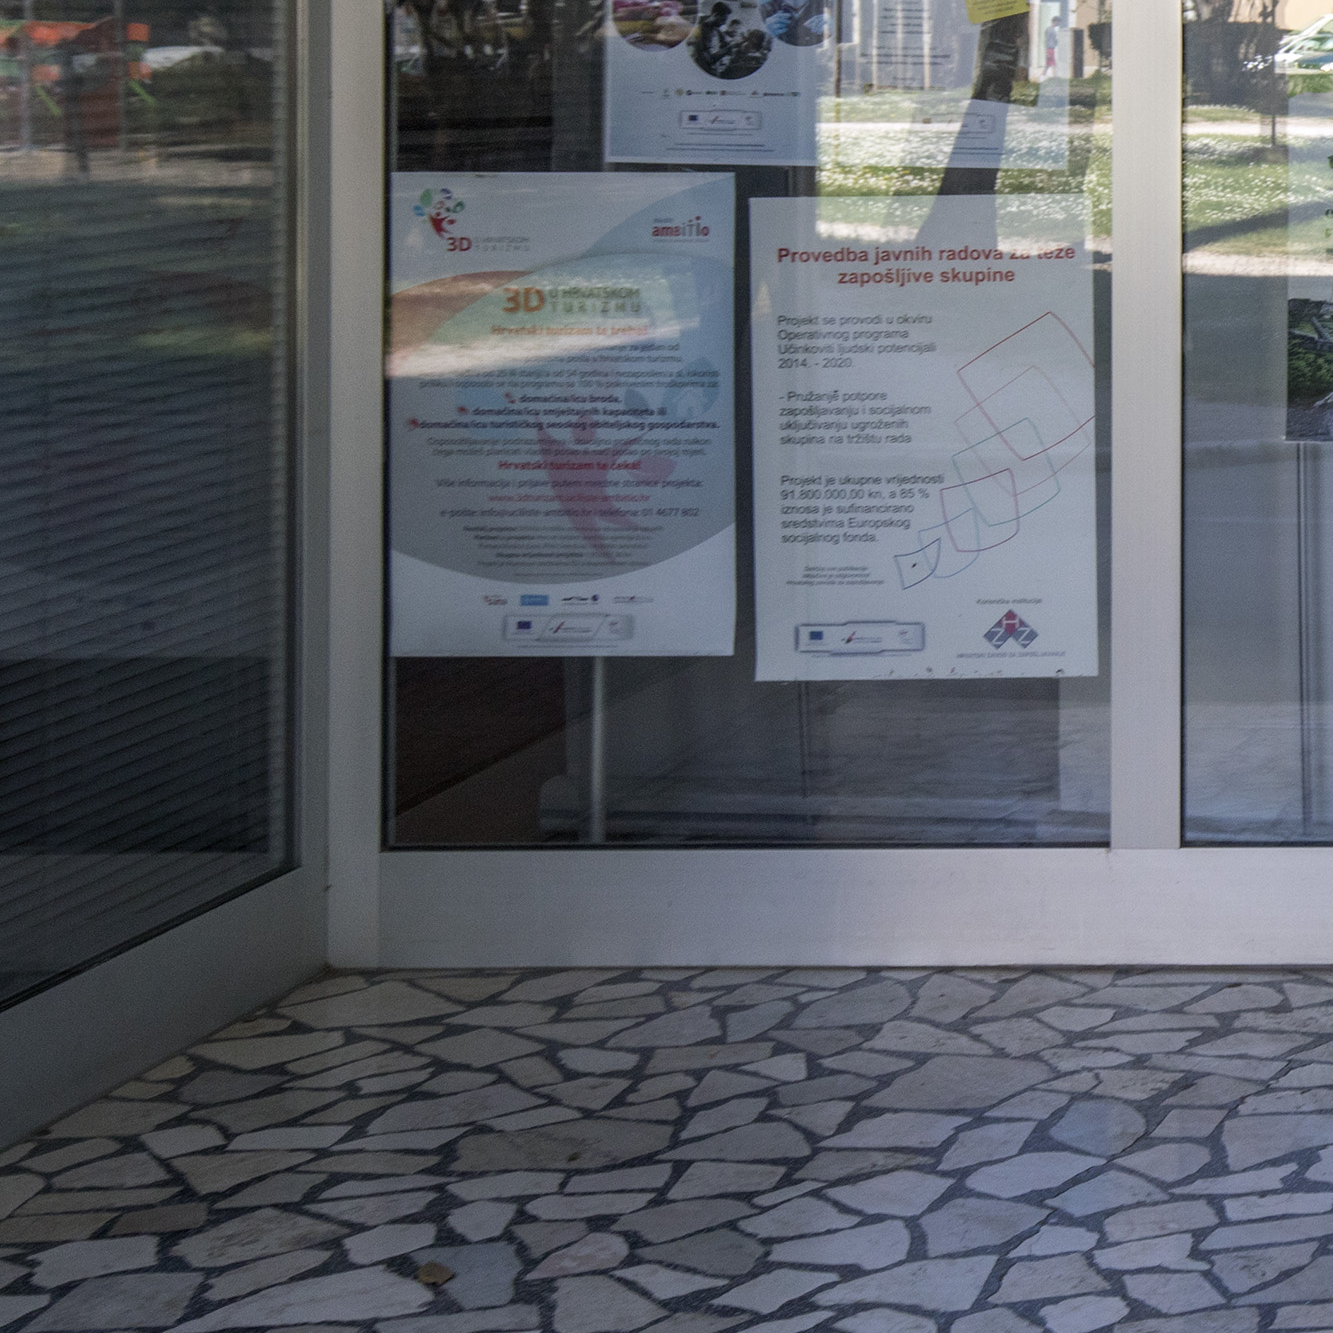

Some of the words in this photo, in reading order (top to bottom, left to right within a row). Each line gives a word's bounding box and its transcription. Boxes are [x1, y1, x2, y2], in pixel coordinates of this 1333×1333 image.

[446, 236, 472, 252] 3D
[777, 246, 869, 263] Provedba
[874, 246, 932, 266] javnih
[938, 245, 1004, 261] radova
[1009, 248, 1030, 260] za
[1037, 245, 1076, 260] teže
[838, 268, 933, 287] zapošljive
[939, 267, 1016, 286] skupine
[502, 288, 546, 313] 3D
[777, 314, 820, 327] Projekt
[823, 317, 836, 326] se
[780, 475, 822, 487] Projekt
[824, 475, 836, 487] je
